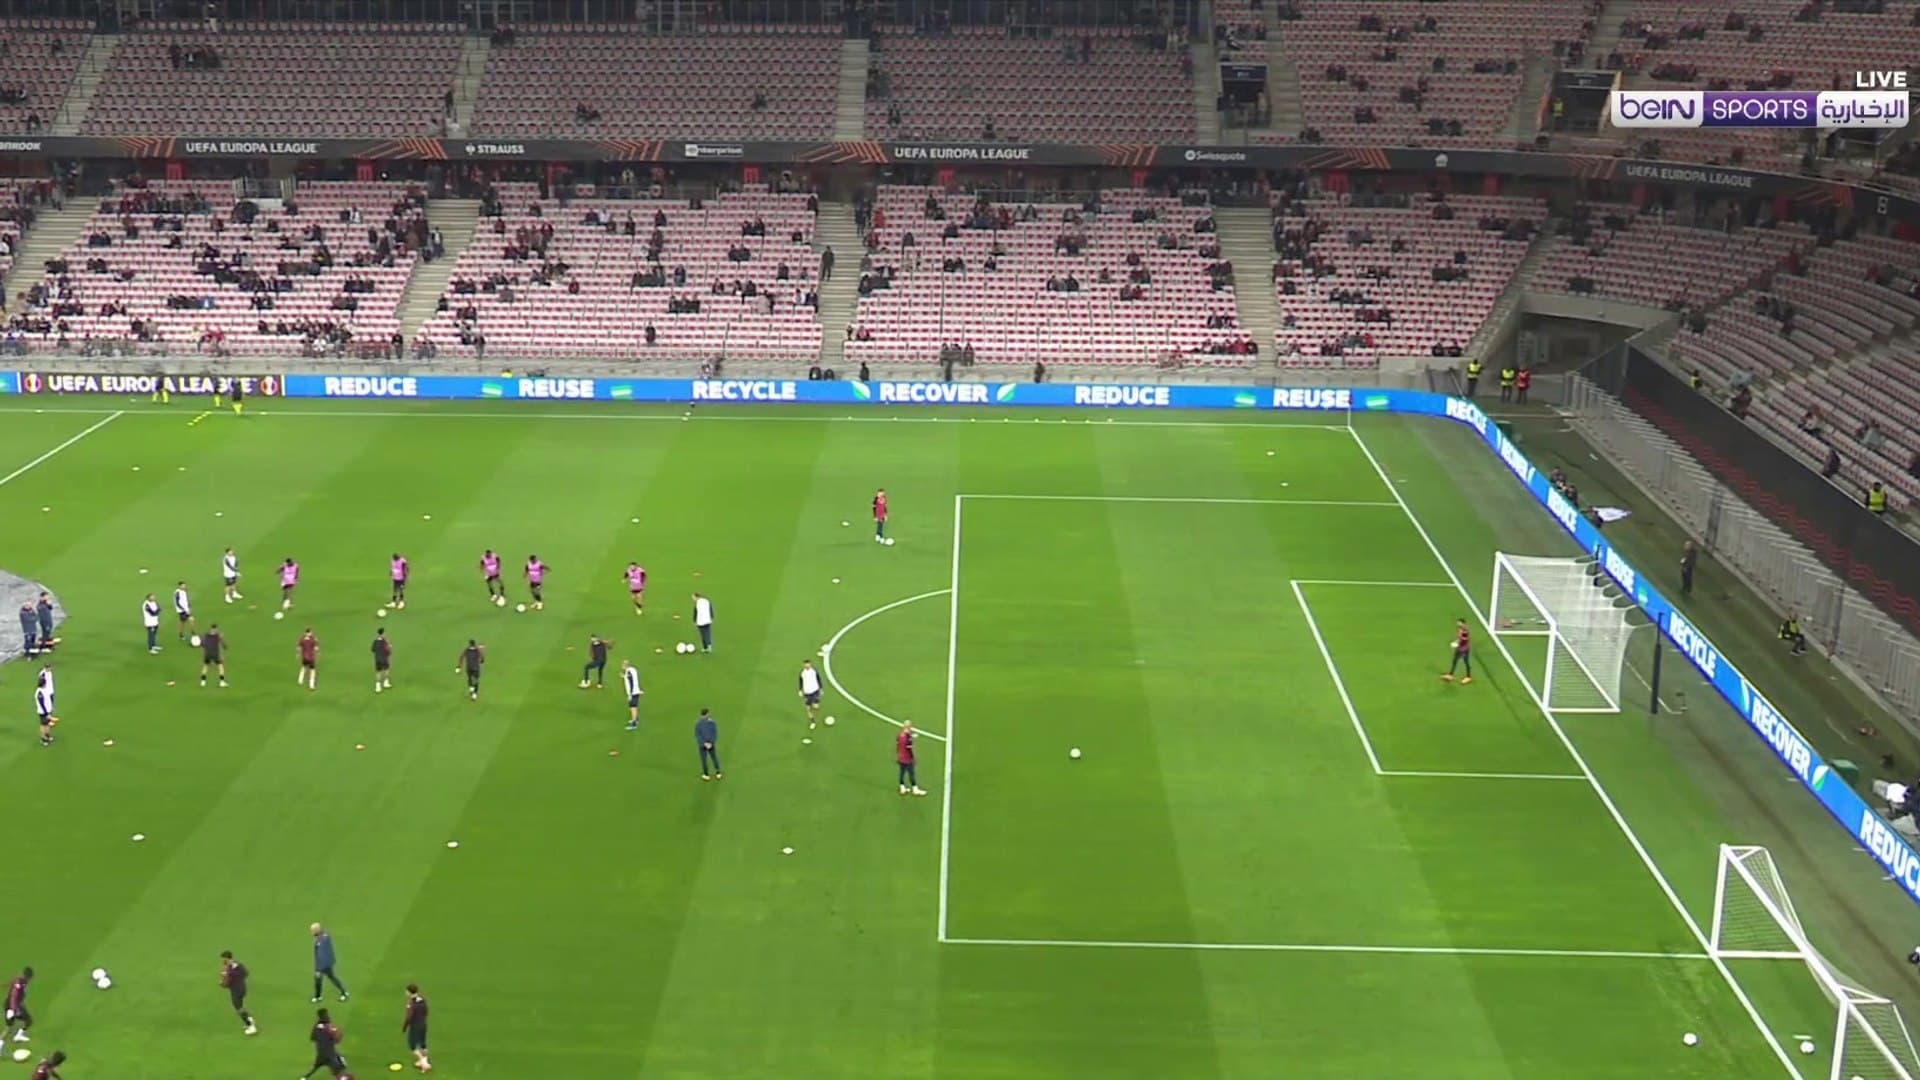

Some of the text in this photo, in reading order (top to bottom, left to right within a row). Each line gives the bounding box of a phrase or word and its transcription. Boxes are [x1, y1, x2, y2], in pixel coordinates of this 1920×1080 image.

[185, 142, 317, 154] UEFA EUROPA LEAGUE
[477, 144, 525, 154] STRAUSS
[894, 147, 1029, 160] UEFA EUROPA LEAGUE
[1626, 164, 1753, 188] UEFA EUROPA LEAGUE
[48, 375, 99, 392] UEFA
[324, 376, 1351, 408] REDUCE REUSE RECYCLE RECOVER REDUCE REUSE
[1669, 611, 1716, 679] RECYCLE
[1751, 696, 1811, 781] RECOVER
